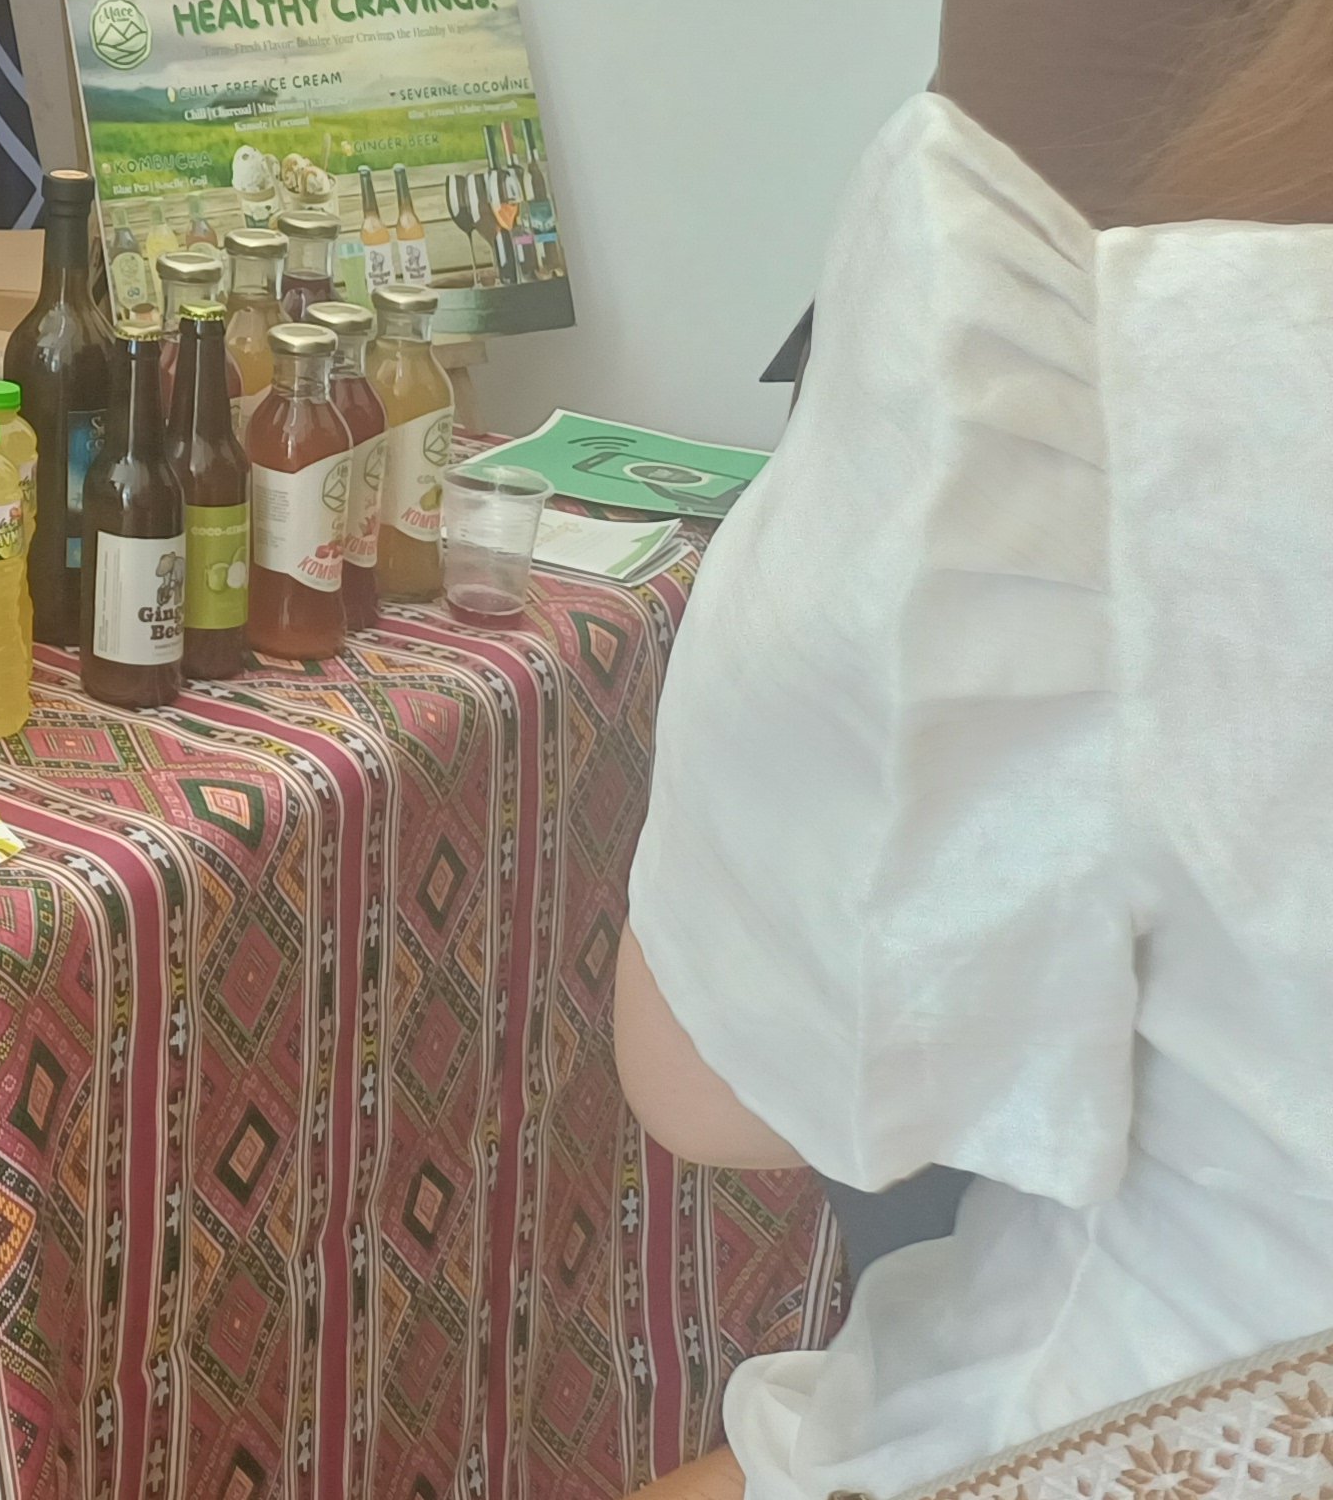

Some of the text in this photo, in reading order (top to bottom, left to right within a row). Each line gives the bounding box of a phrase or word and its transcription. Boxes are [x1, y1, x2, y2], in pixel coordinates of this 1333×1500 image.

[333, 34, 355, 46] Your
[356, 30, 396, 44] Cravings
[396, 28, 412, 40] the
[413, 25, 447, 40] Healthy
[225, 79, 259, 94] FREE
[264, 76, 287, 92] ICE
[292, 71, 343, 88] CREAM
[399, 75, 531, 101] SEVERINE COCOWINE
[183, 108, 208, 122] Chili
[353, 133, 440, 154] GINGER BEER
[114, 154, 213, 175] KOMBUCHA
[113, 182, 132, 195] Blue
[133, 181, 150, 194] Pea
[137, 606, 183, 624] Ging
[149, 624, 183, 641] Bee
